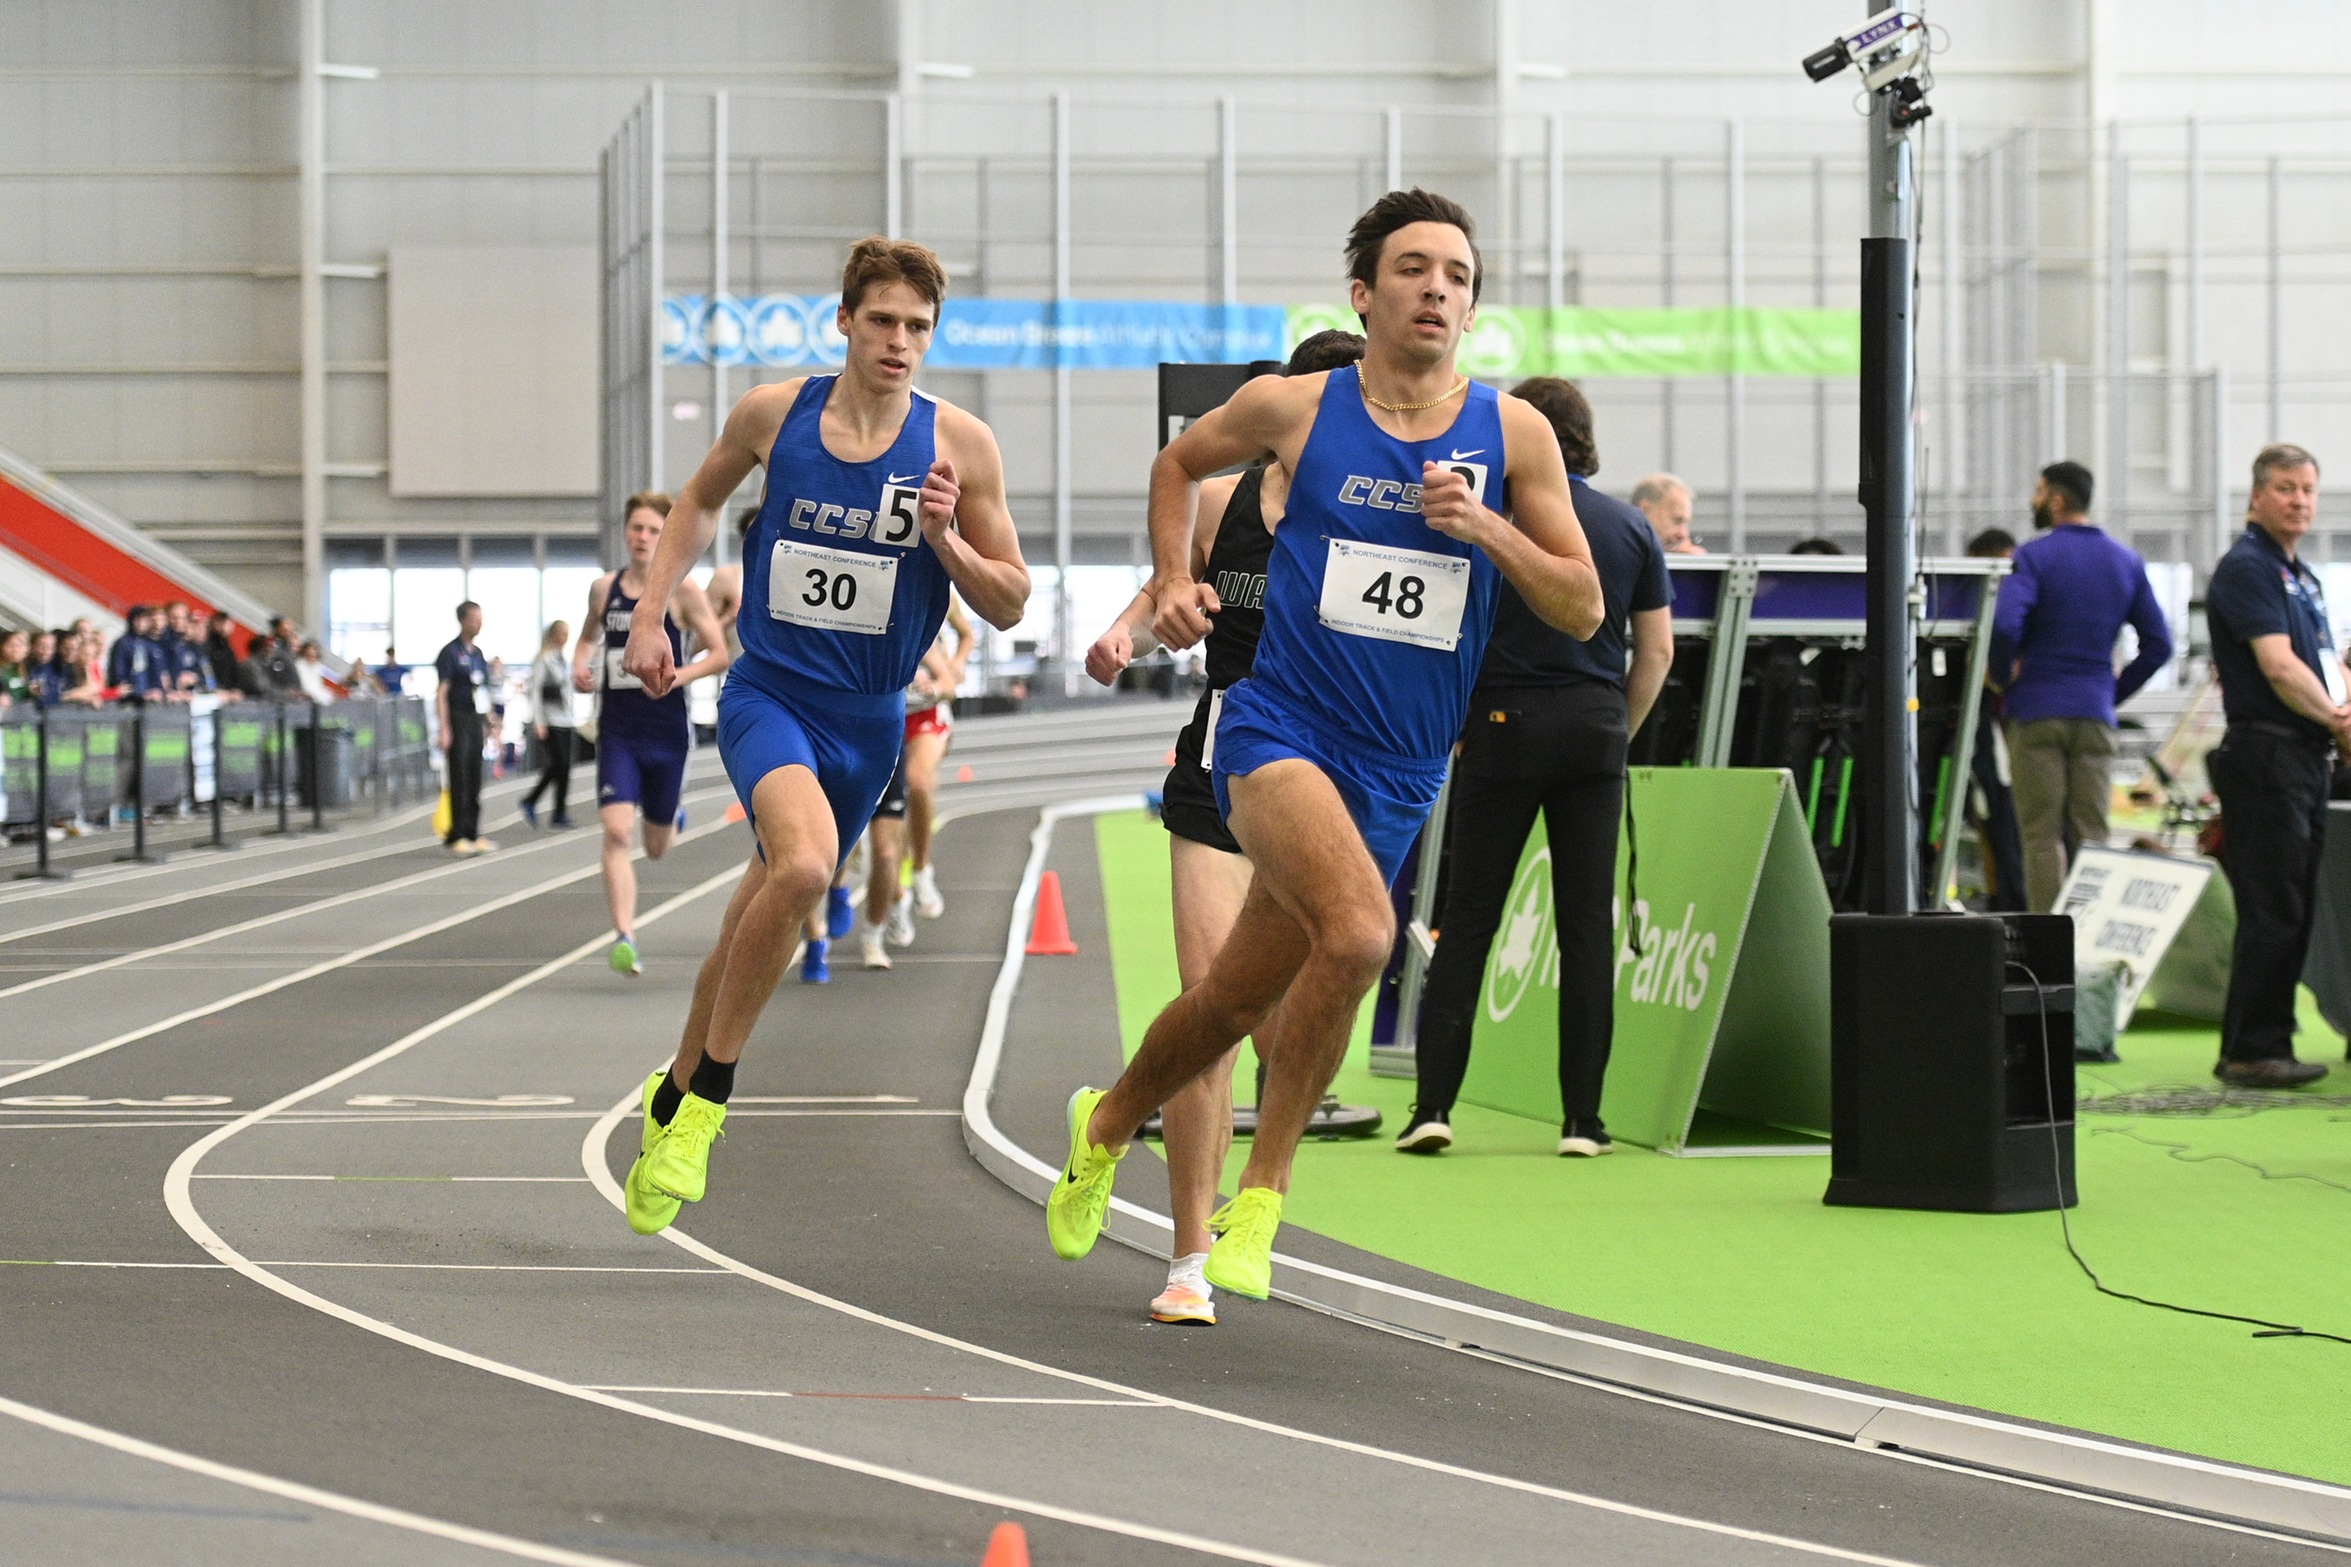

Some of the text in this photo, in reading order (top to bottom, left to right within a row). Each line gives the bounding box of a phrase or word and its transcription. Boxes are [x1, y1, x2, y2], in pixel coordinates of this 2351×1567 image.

[1861, 18, 1898, 45] LYNX
[789, 498, 879, 541] CCS
[885, 489, 918, 543] 5
[794, 549, 877, 568] NORTHEAST CONFERENCE
[1352, 549, 1448, 570] NORTHEAST CONFERENCE
[801, 568, 857, 611] 30
[1362, 571, 1426, 619] 48
[796, 614, 813, 622] TRACK
[1331, 619, 1354, 628] INDOOR
[1355, 623, 1375, 632] TRACK
[1381, 628, 1399, 636] FIELD
[1399, 630, 1445, 643] CHAMPIONSHIPS
[1614, 899, 1717, 1011] Parks
